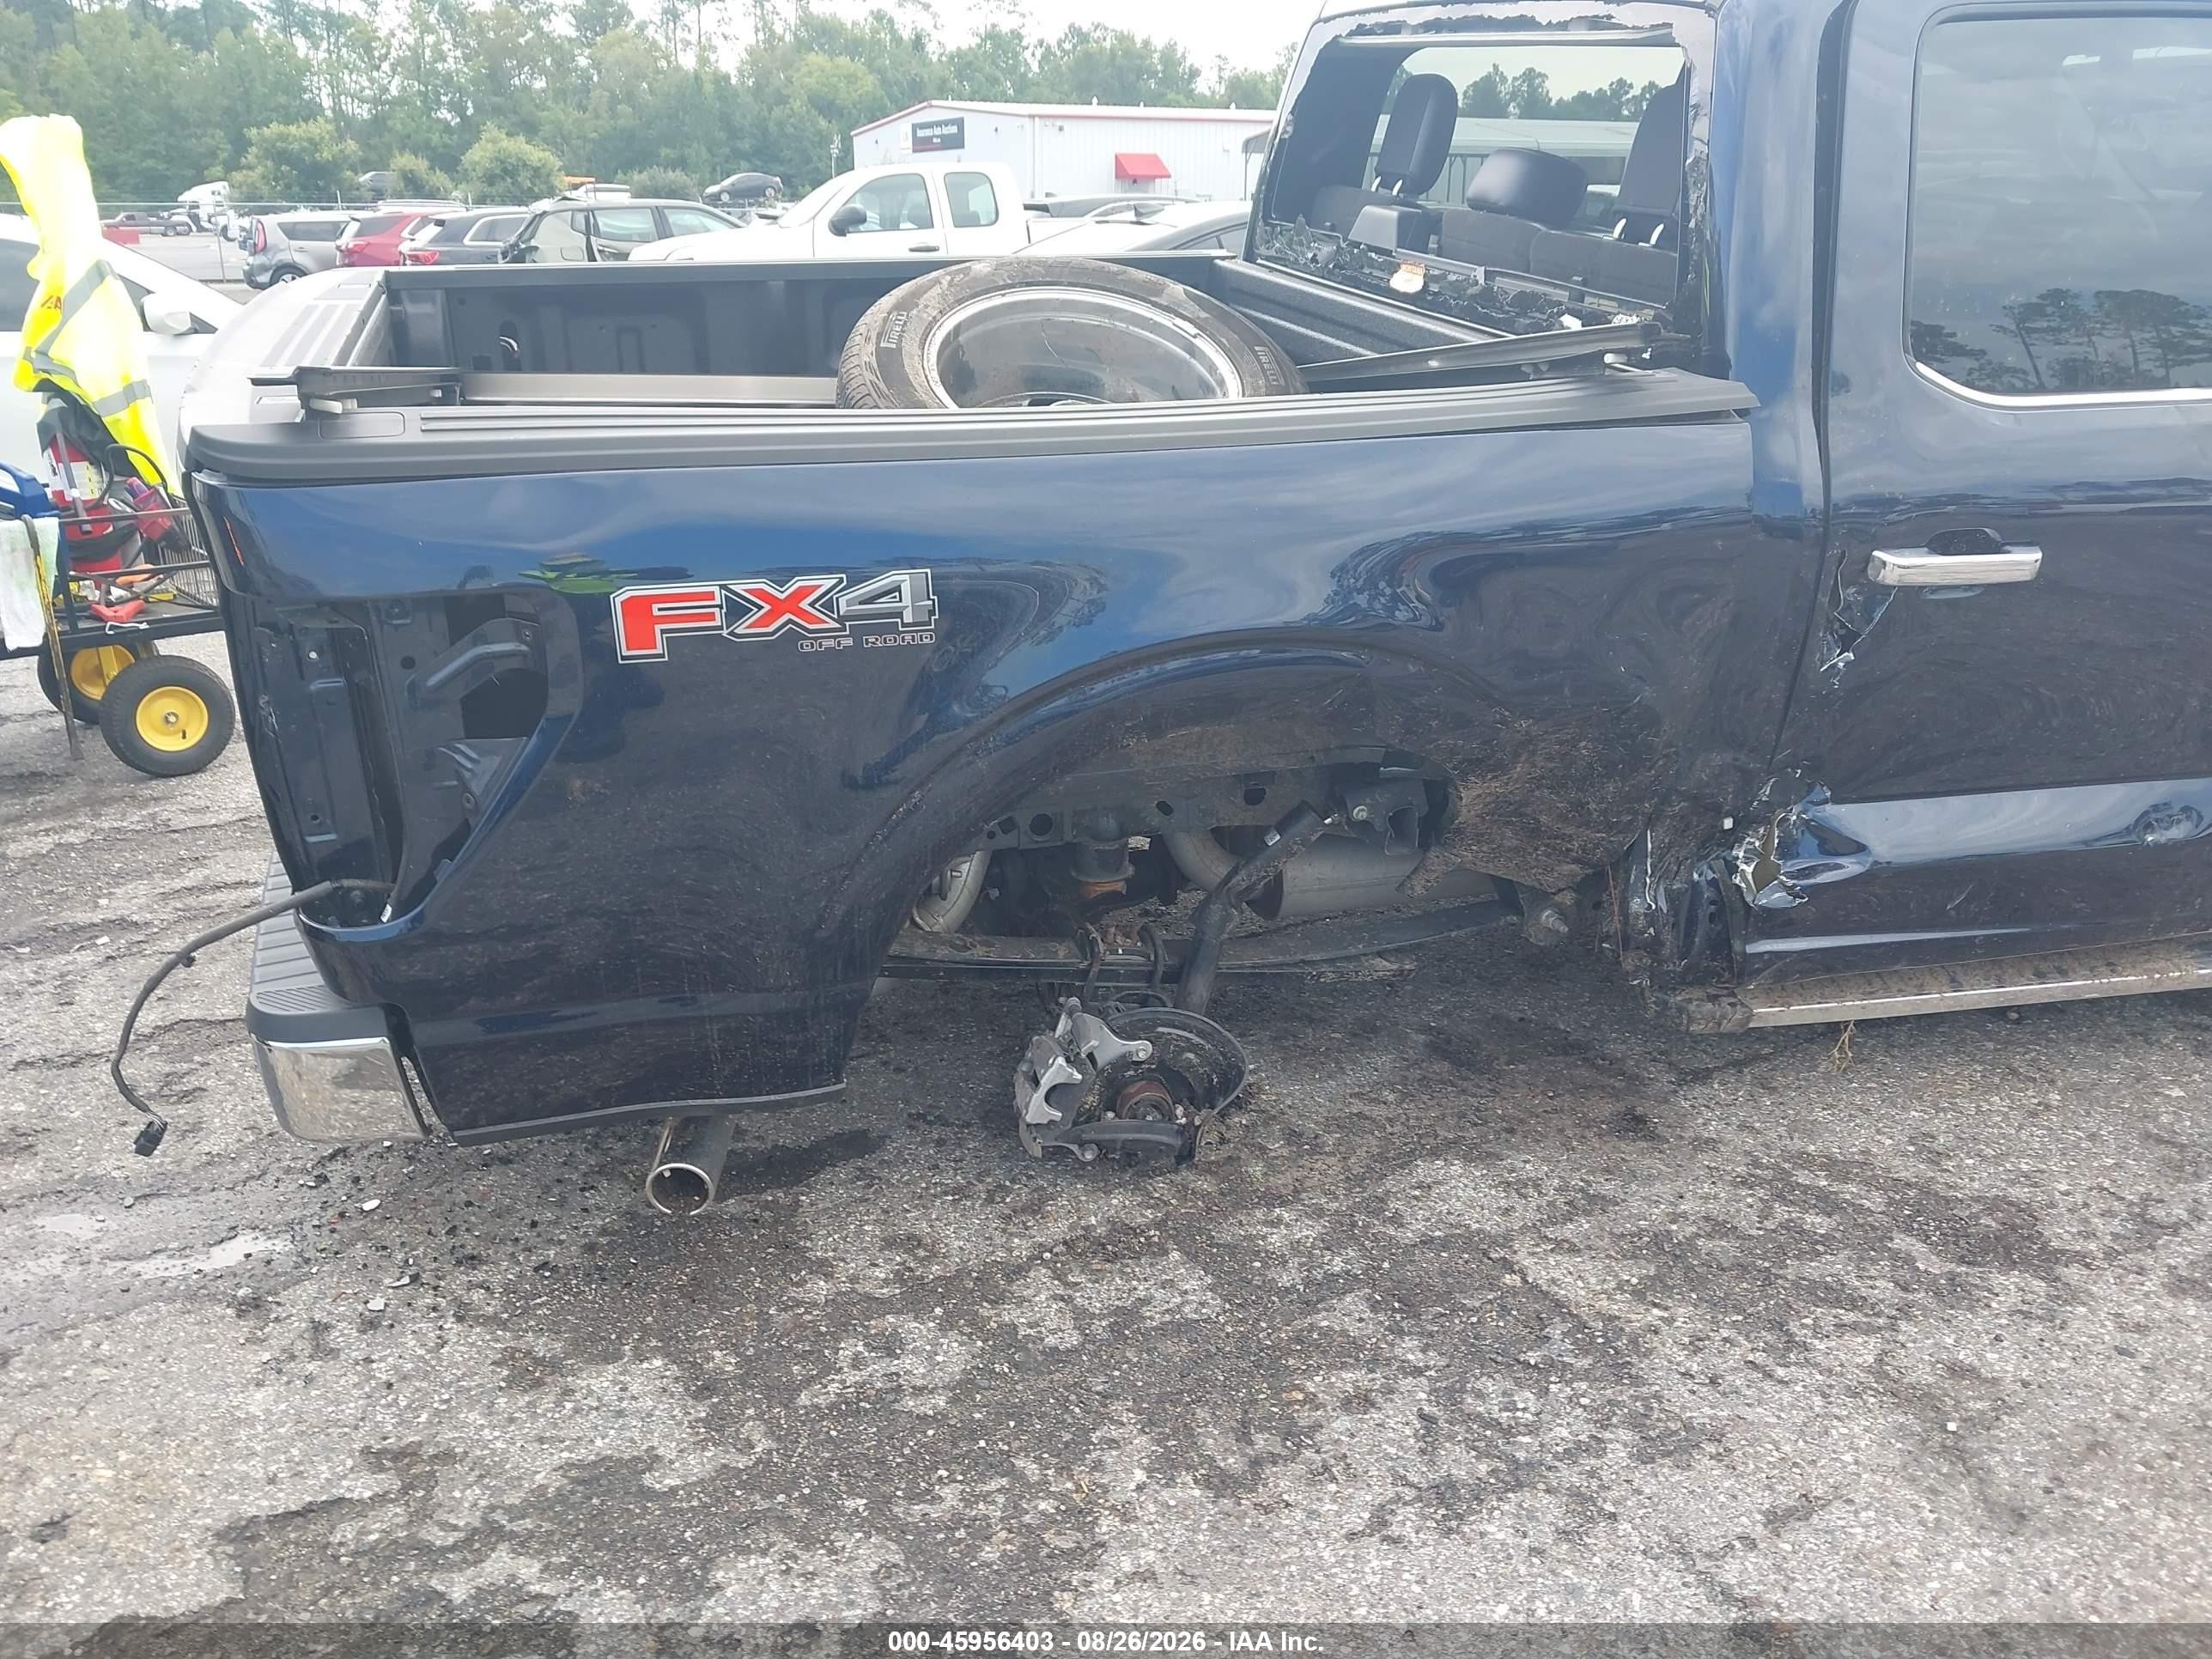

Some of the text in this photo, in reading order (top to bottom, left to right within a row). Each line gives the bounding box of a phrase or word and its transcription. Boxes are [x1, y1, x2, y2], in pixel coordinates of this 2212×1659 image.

[880, 311, 908, 349] PIRELLI
[1254, 345, 1285, 386] PIRELLI
[610, 568, 939, 664] FX4
[797, 631, 937, 653] OFF ROAD
